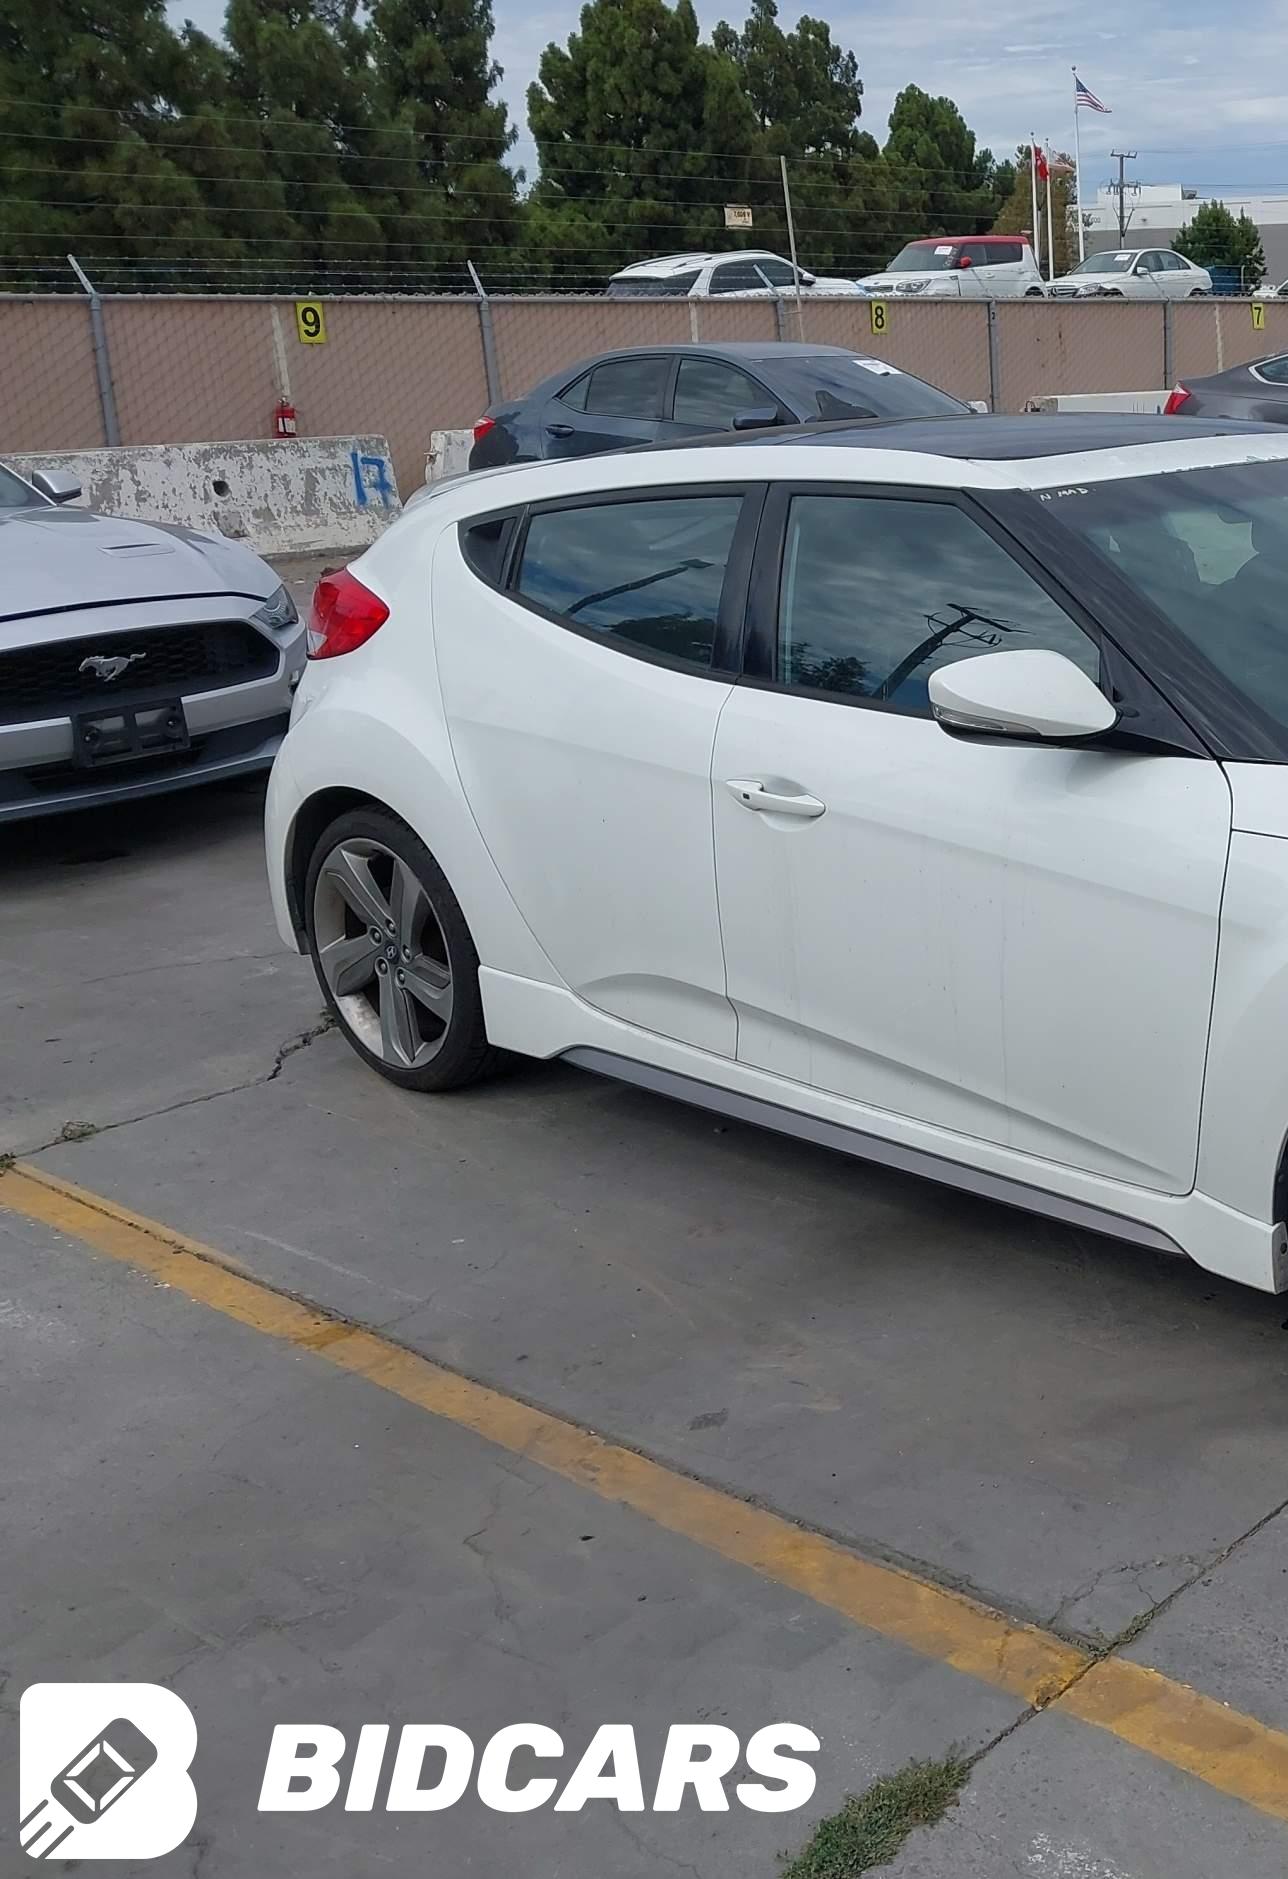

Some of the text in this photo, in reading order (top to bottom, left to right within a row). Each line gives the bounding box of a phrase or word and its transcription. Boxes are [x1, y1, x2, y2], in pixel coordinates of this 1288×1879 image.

[301, 306, 321, 338] 9
[874, 305, 885, 329] 8
[1253, 306, 1262, 325] 7
[350, 451, 393, 511] 17
